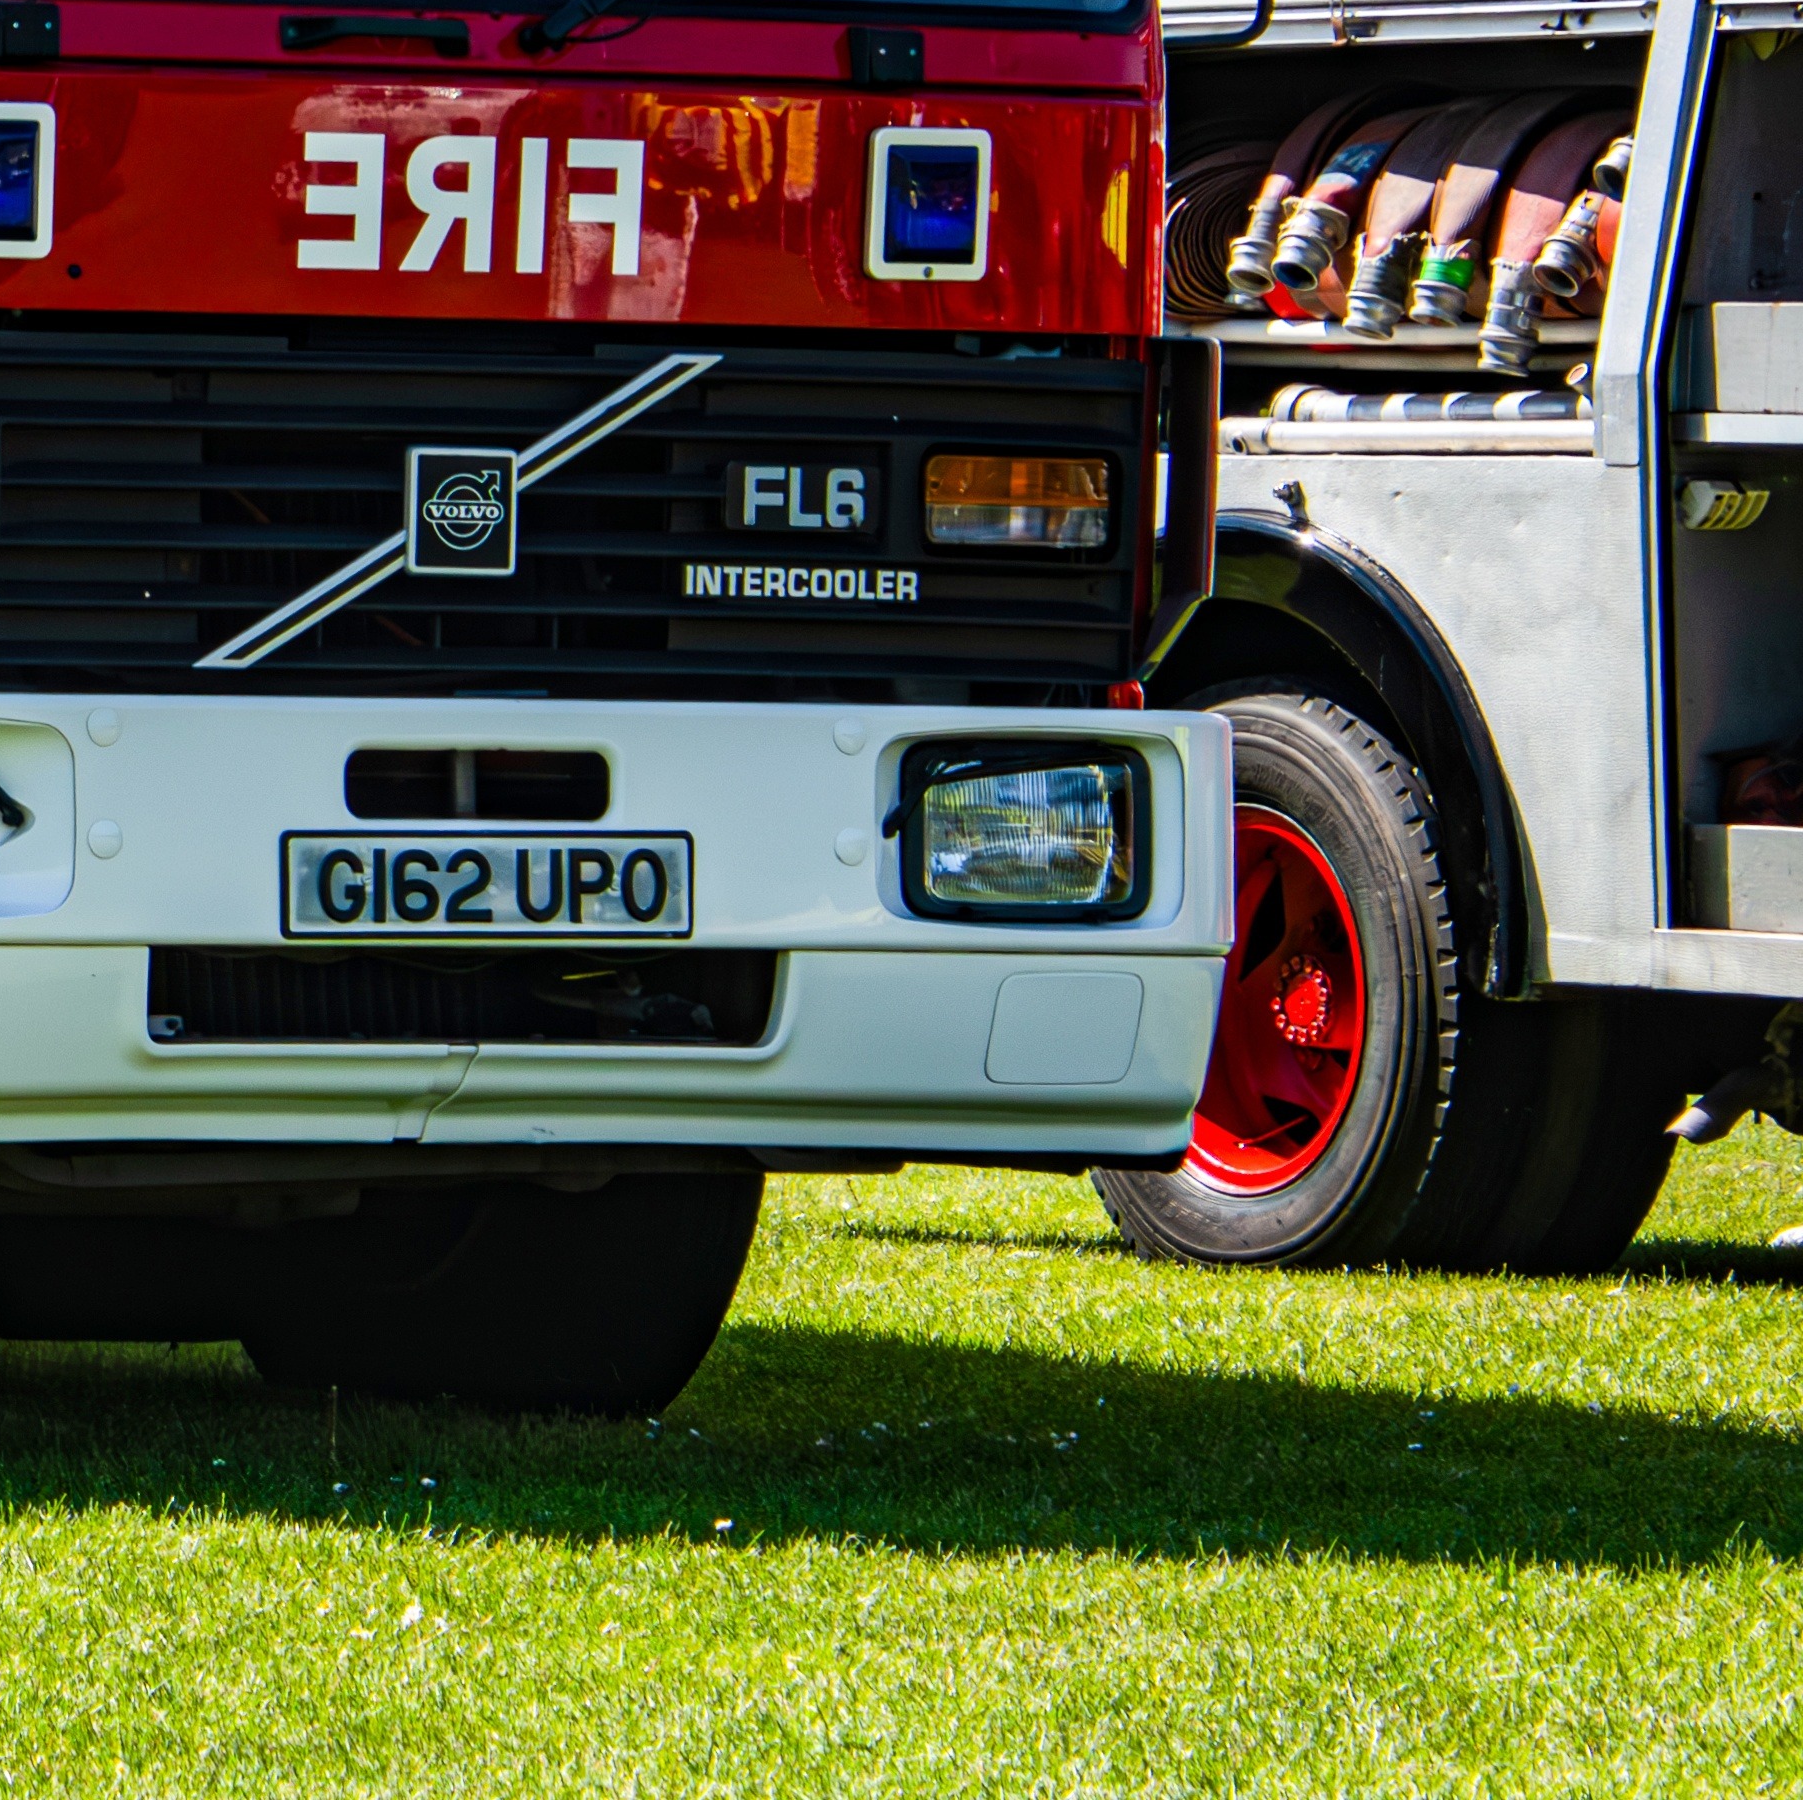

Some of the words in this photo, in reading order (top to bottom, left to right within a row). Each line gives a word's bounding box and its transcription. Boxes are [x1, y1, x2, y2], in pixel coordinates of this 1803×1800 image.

[428, 504, 500, 519] VOLVO
[743, 465, 865, 528] FL6
[685, 563, 919, 602] INTERCOOLER
[317, 848, 493, 923] G162
